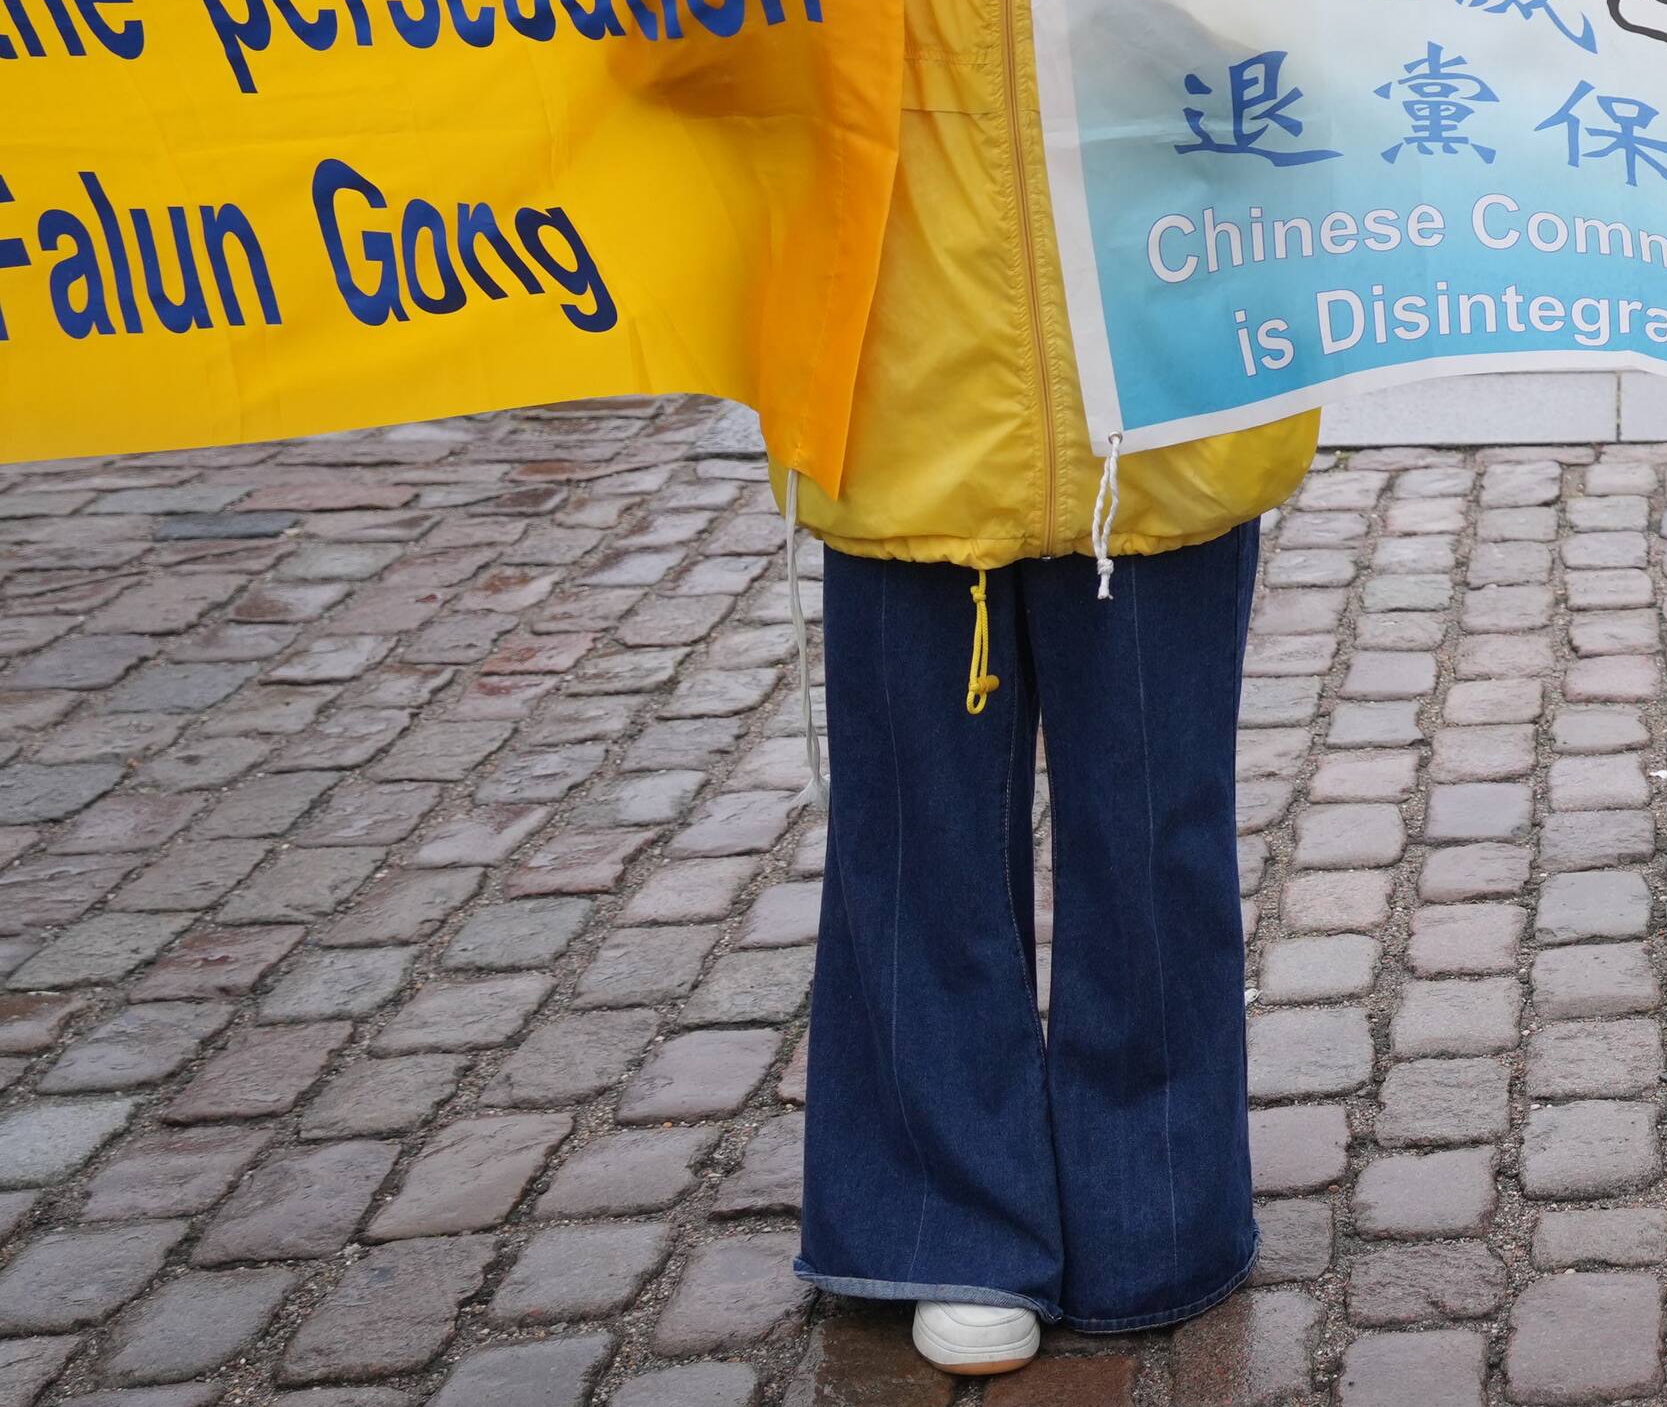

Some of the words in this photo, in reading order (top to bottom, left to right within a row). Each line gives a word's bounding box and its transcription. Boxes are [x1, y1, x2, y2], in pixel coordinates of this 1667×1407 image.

[311, 158, 619, 334] Gong
[1147, 202, 1447, 284] Chinese
[1235, 310, 1295, 377] is
